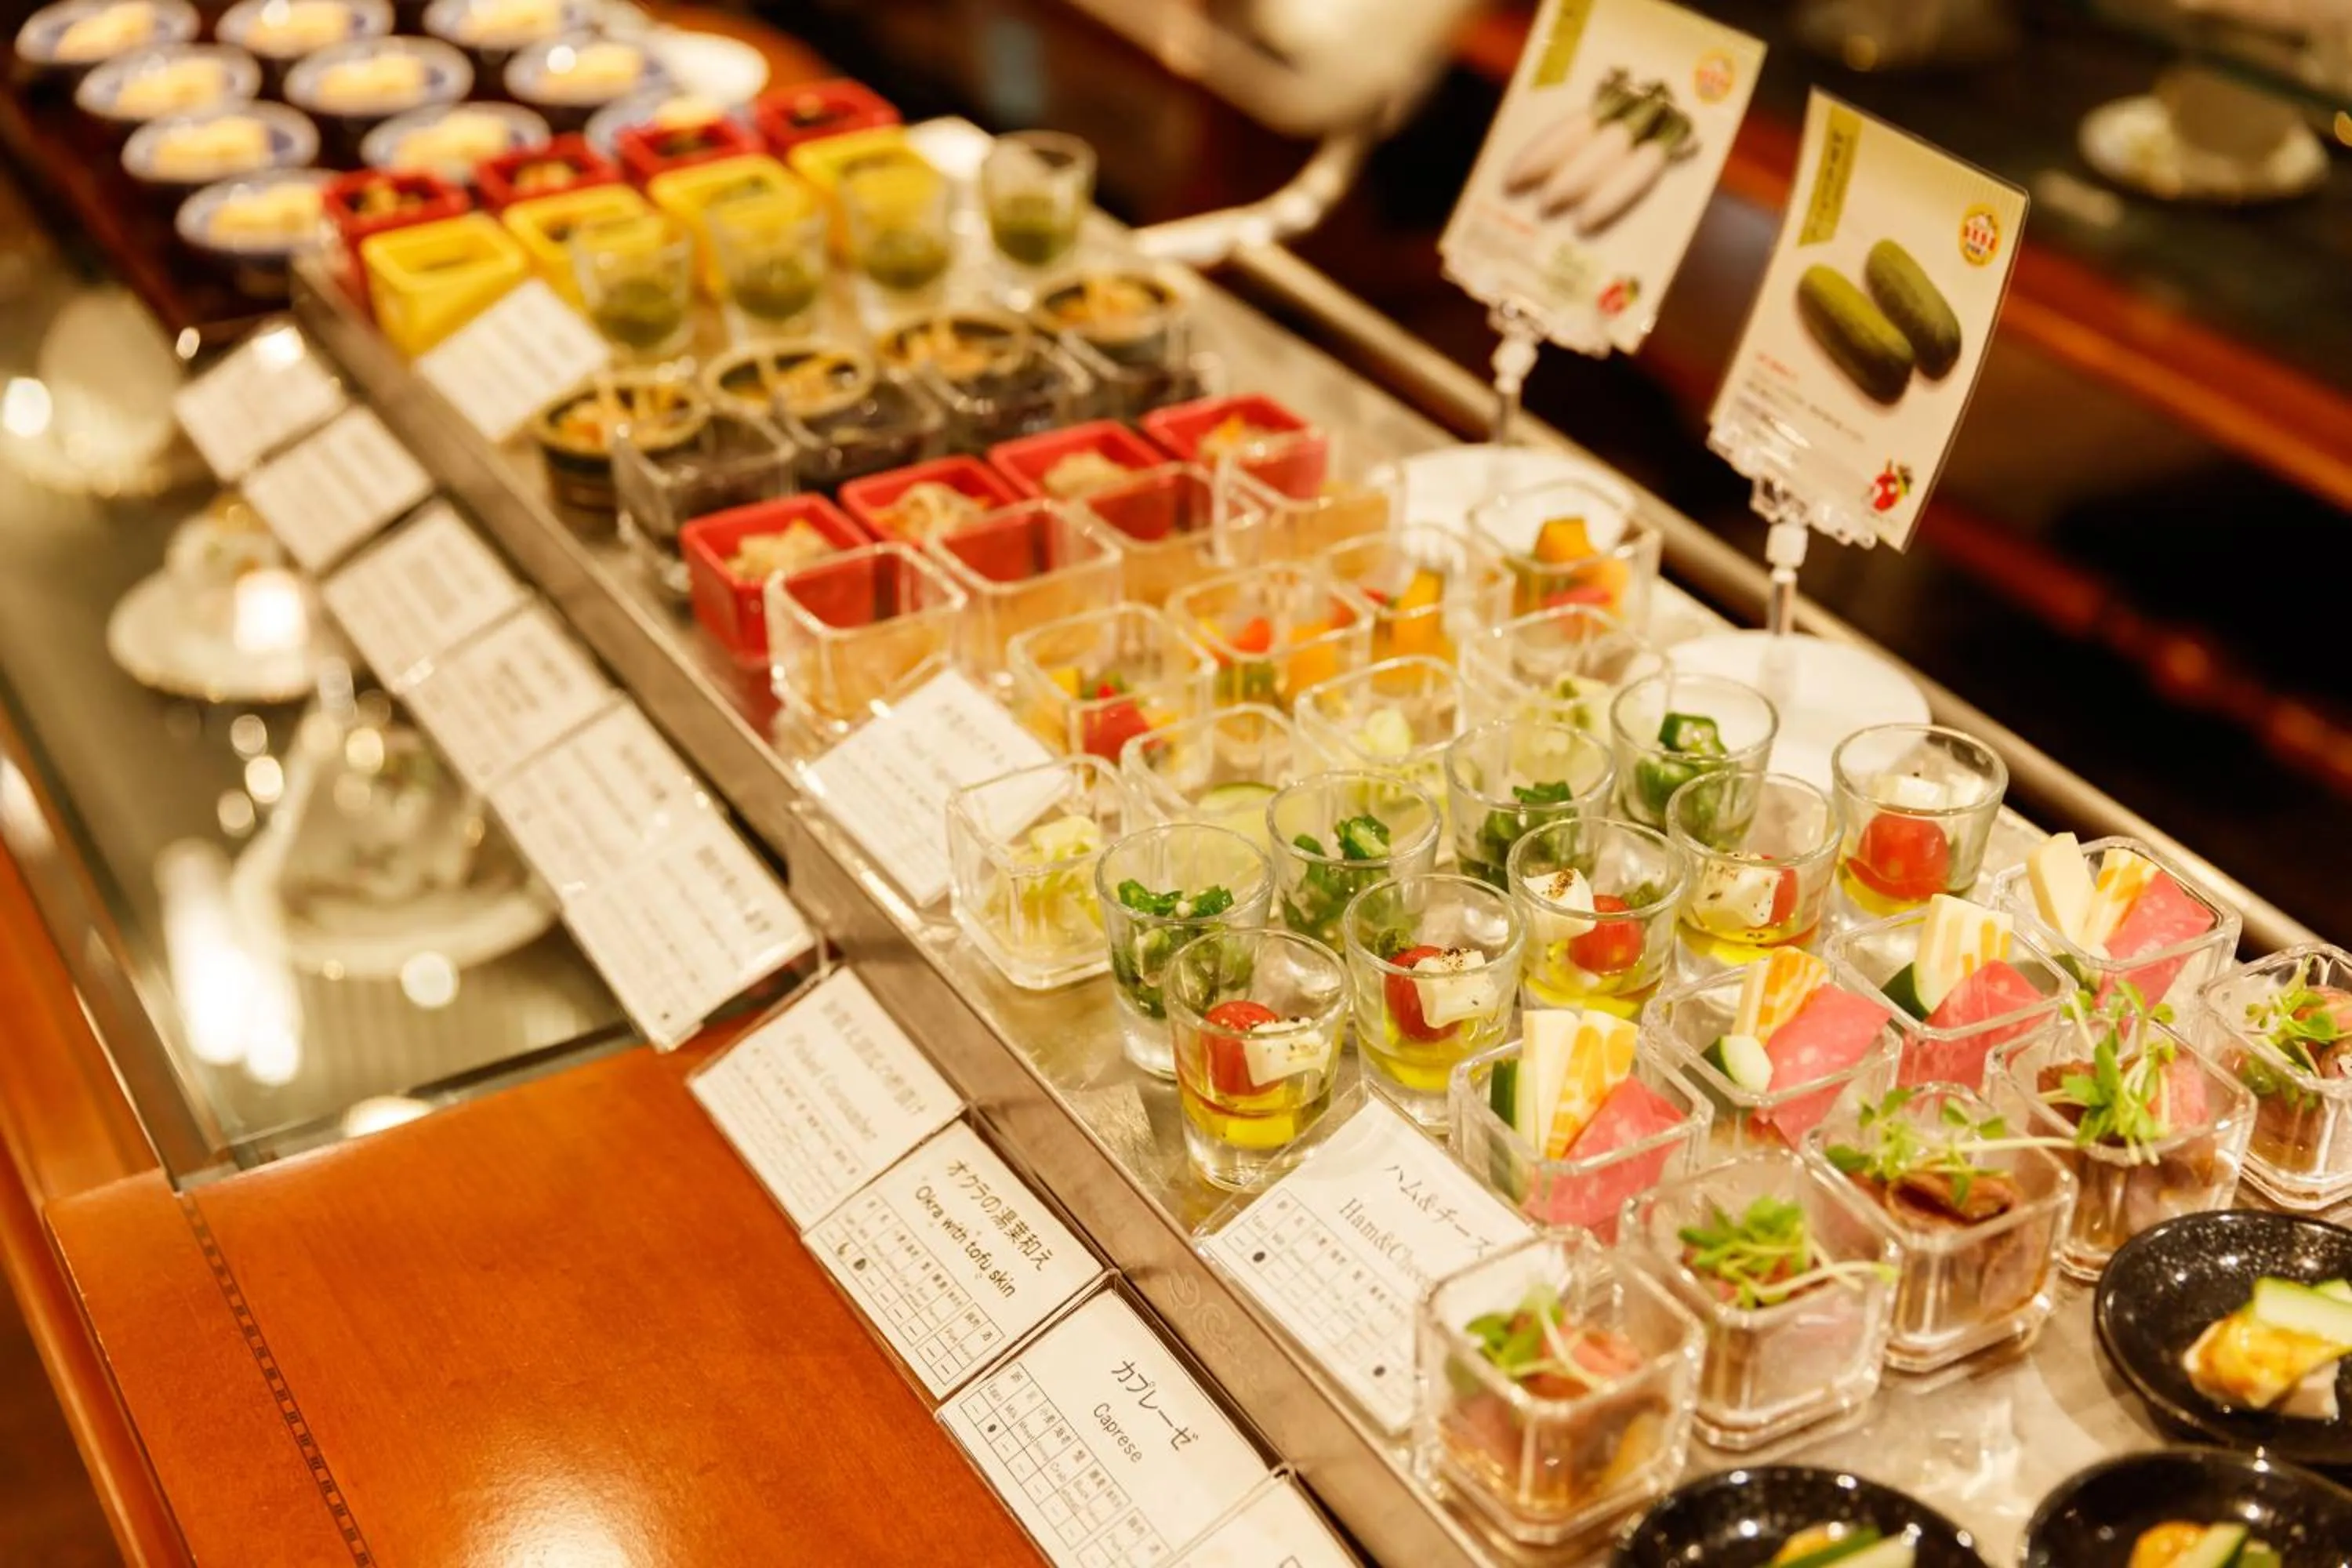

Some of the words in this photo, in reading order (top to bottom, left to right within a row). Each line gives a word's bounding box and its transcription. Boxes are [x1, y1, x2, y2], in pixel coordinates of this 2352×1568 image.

[915, 1185, 944, 1220] Okra
[942, 1218, 968, 1244] with
[965, 1241, 993, 1272] tofu
[988, 1269, 1016, 1298] skin
[946, 1160, 1054, 1272] オクラの湯葉和え
[1093, 1402, 1143, 1463] Caprese
[1110, 1359, 1200, 1452] カプレーゼ
